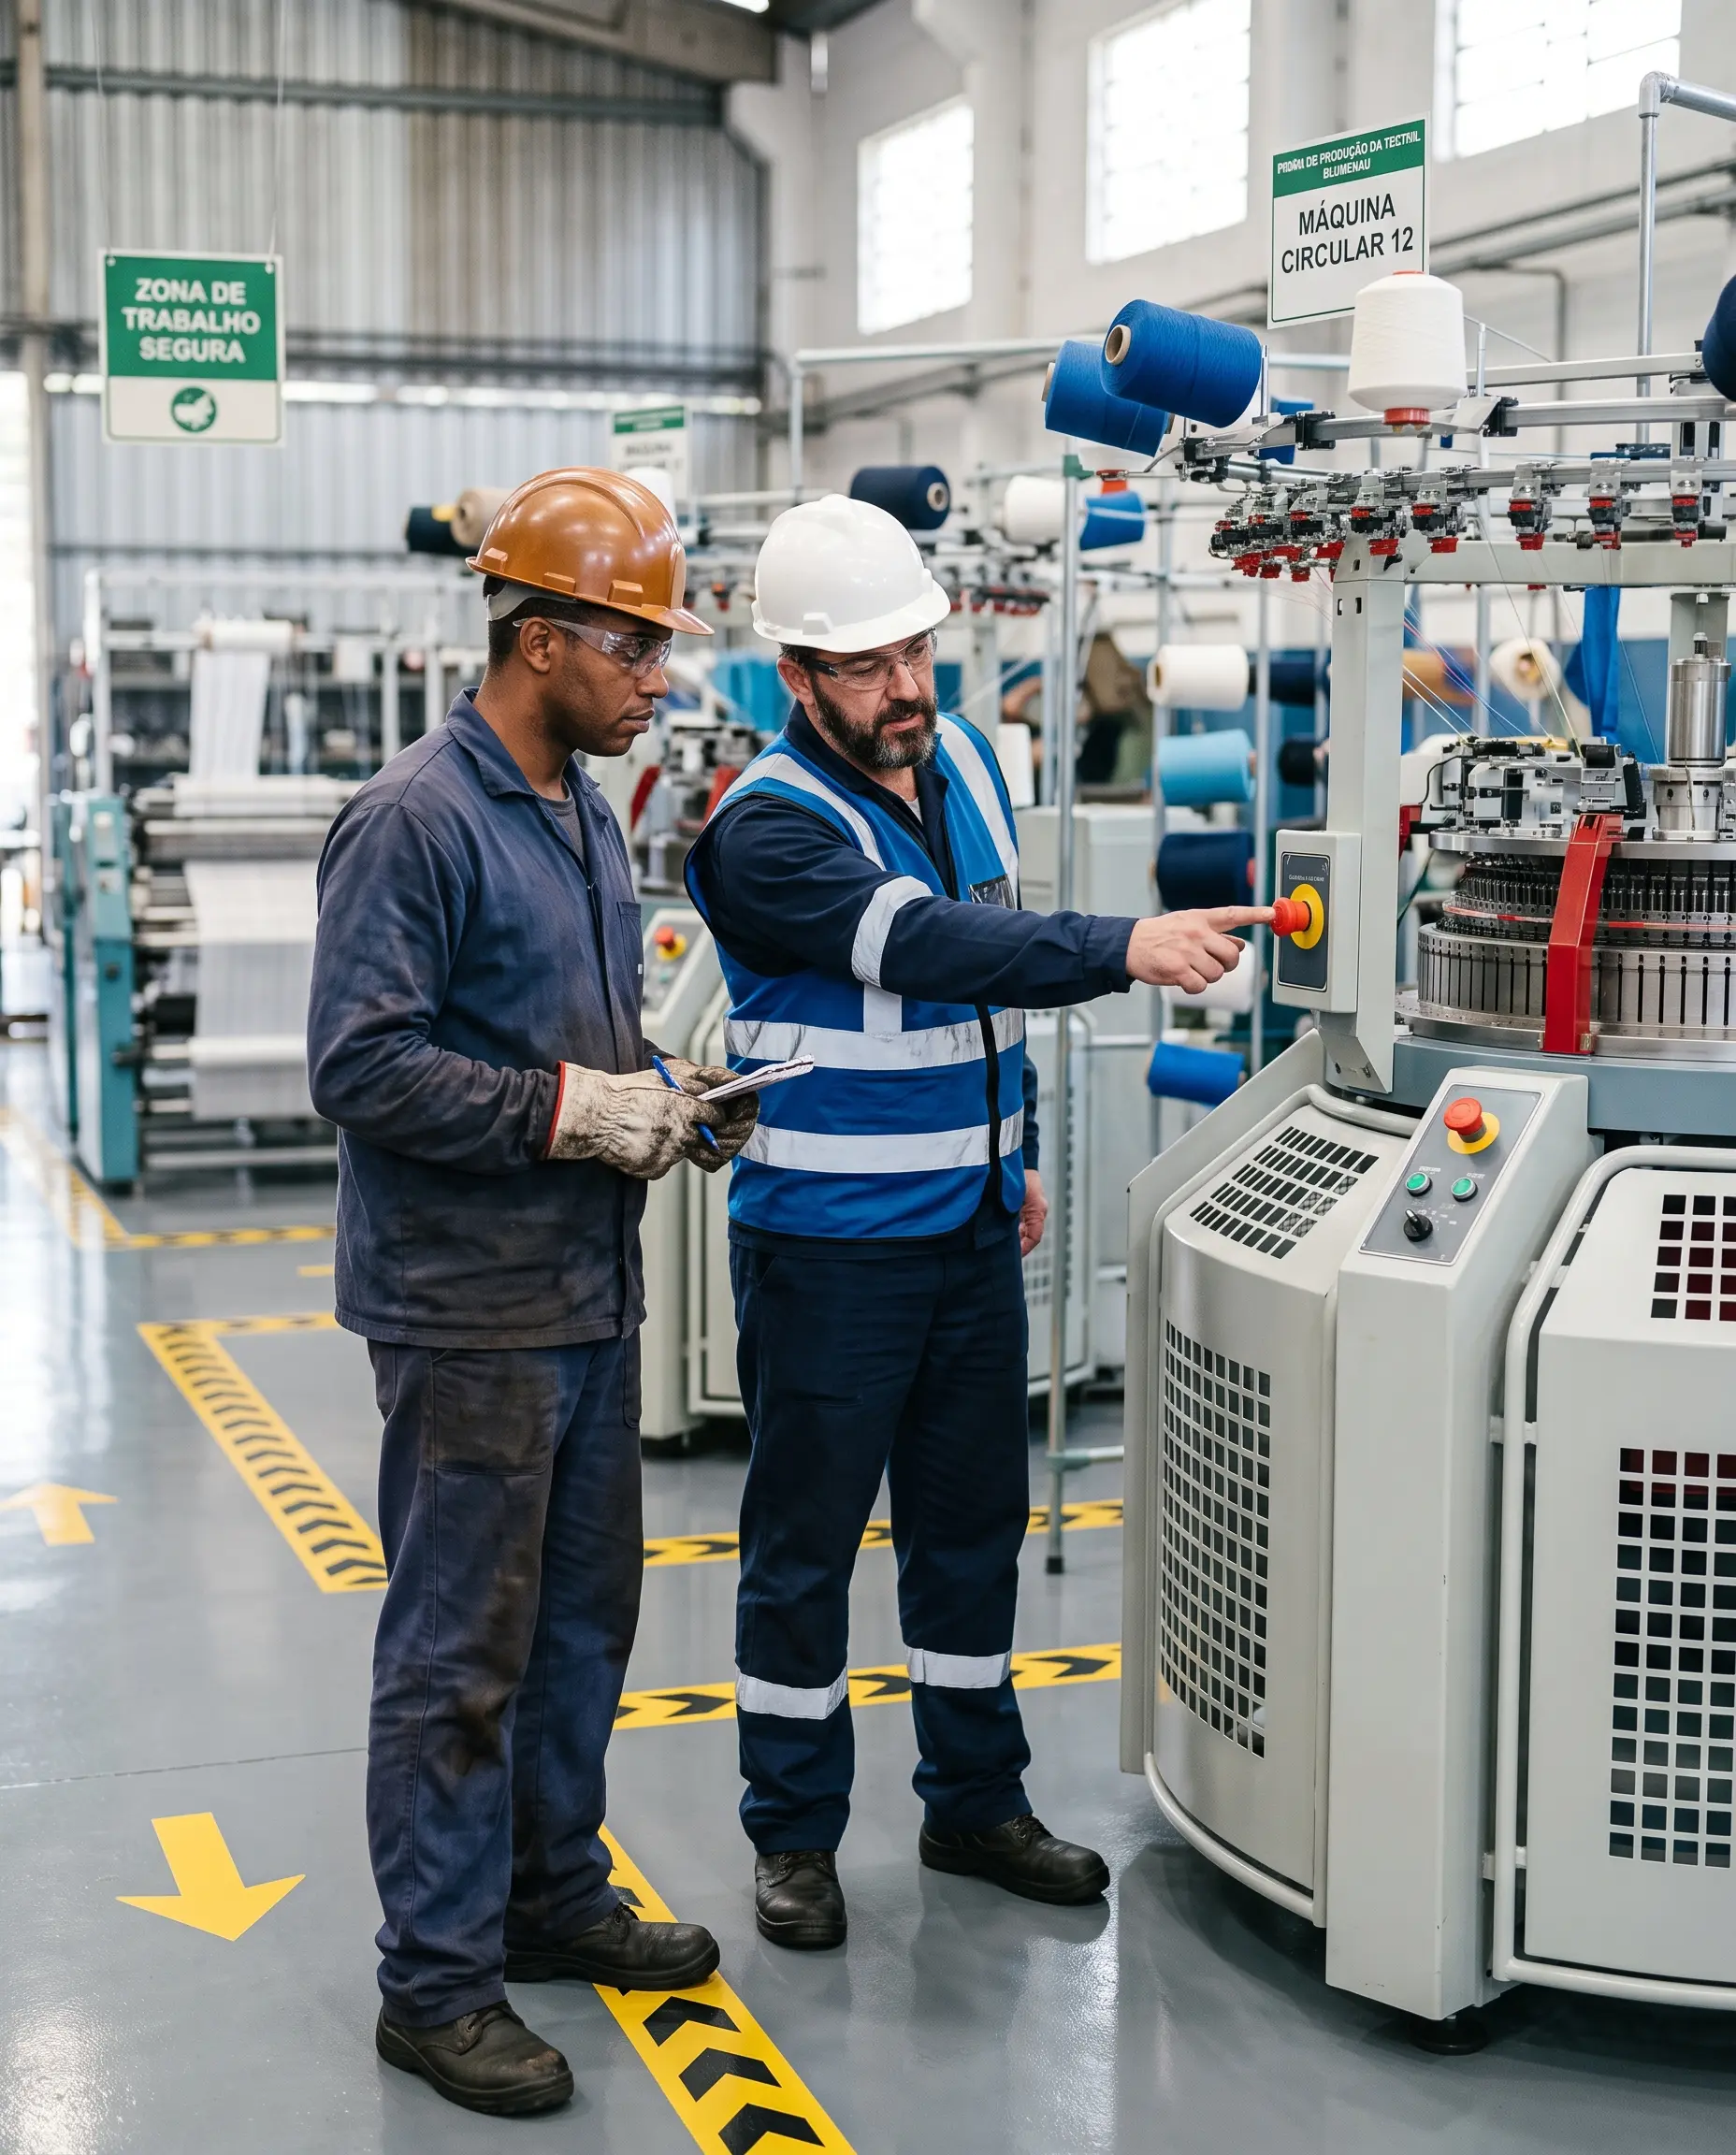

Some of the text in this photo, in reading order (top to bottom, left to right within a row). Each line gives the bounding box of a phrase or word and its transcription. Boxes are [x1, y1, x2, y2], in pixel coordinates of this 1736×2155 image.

[1306, 154, 1318, 168] DE
[1320, 141, 1367, 165] PRODUÇÃO
[1369, 139, 1382, 152] DA
[1323, 158, 1370, 179] BLUMENAU
[1298, 193, 1396, 236] MÁQUINA
[1281, 226, 1413, 274] CIRCULAR 12
[135, 278, 246, 306] ZONA DE
[121, 307, 261, 335] TRABALHO
[139, 336, 246, 364] SEGURA
